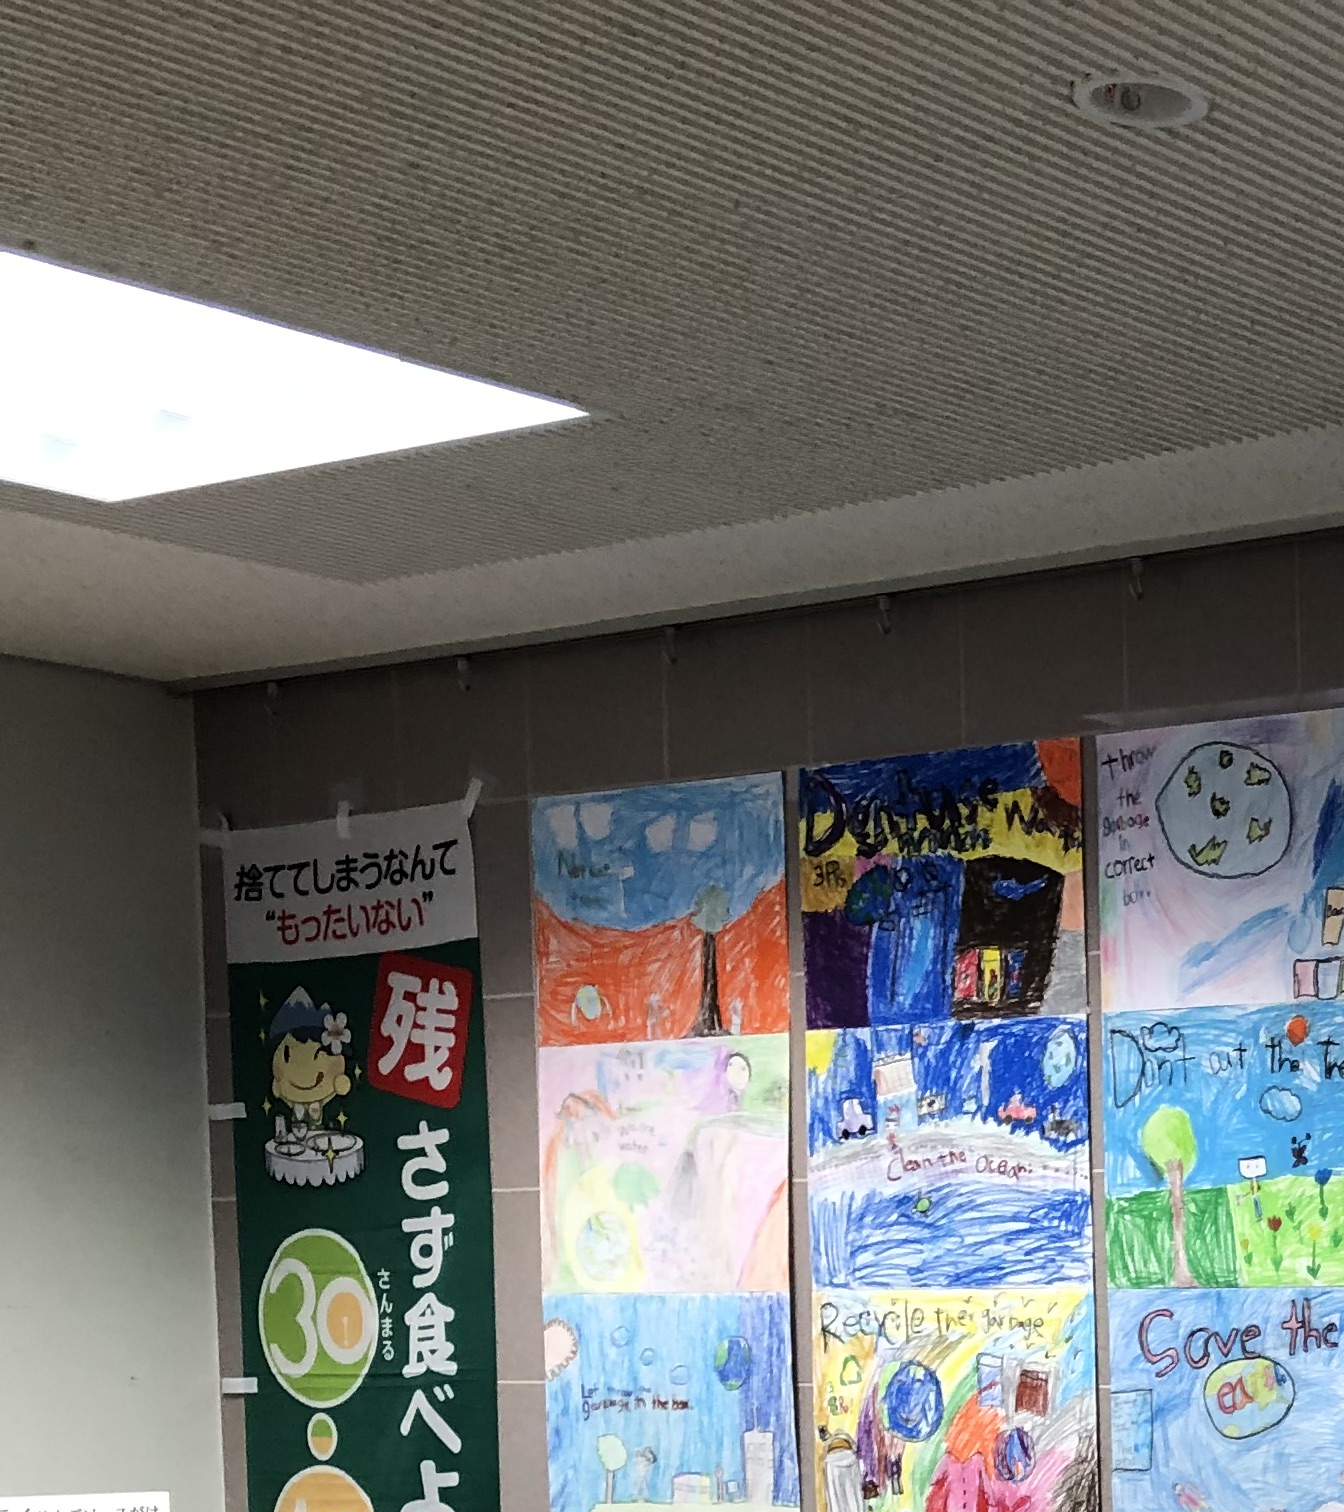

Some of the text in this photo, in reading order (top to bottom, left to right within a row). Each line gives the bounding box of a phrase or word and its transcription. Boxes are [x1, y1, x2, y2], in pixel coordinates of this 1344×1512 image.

[233, 838, 460, 902] 捨ててしまうなんて
[1104, 852, 1156, 879] correct
[1264, 1036, 1301, 1074] the
[376, 1267, 395, 1363] さんまる
[819, 1298, 925, 1354] Recycle
[1138, 1297, 1339, 1379] Save the
